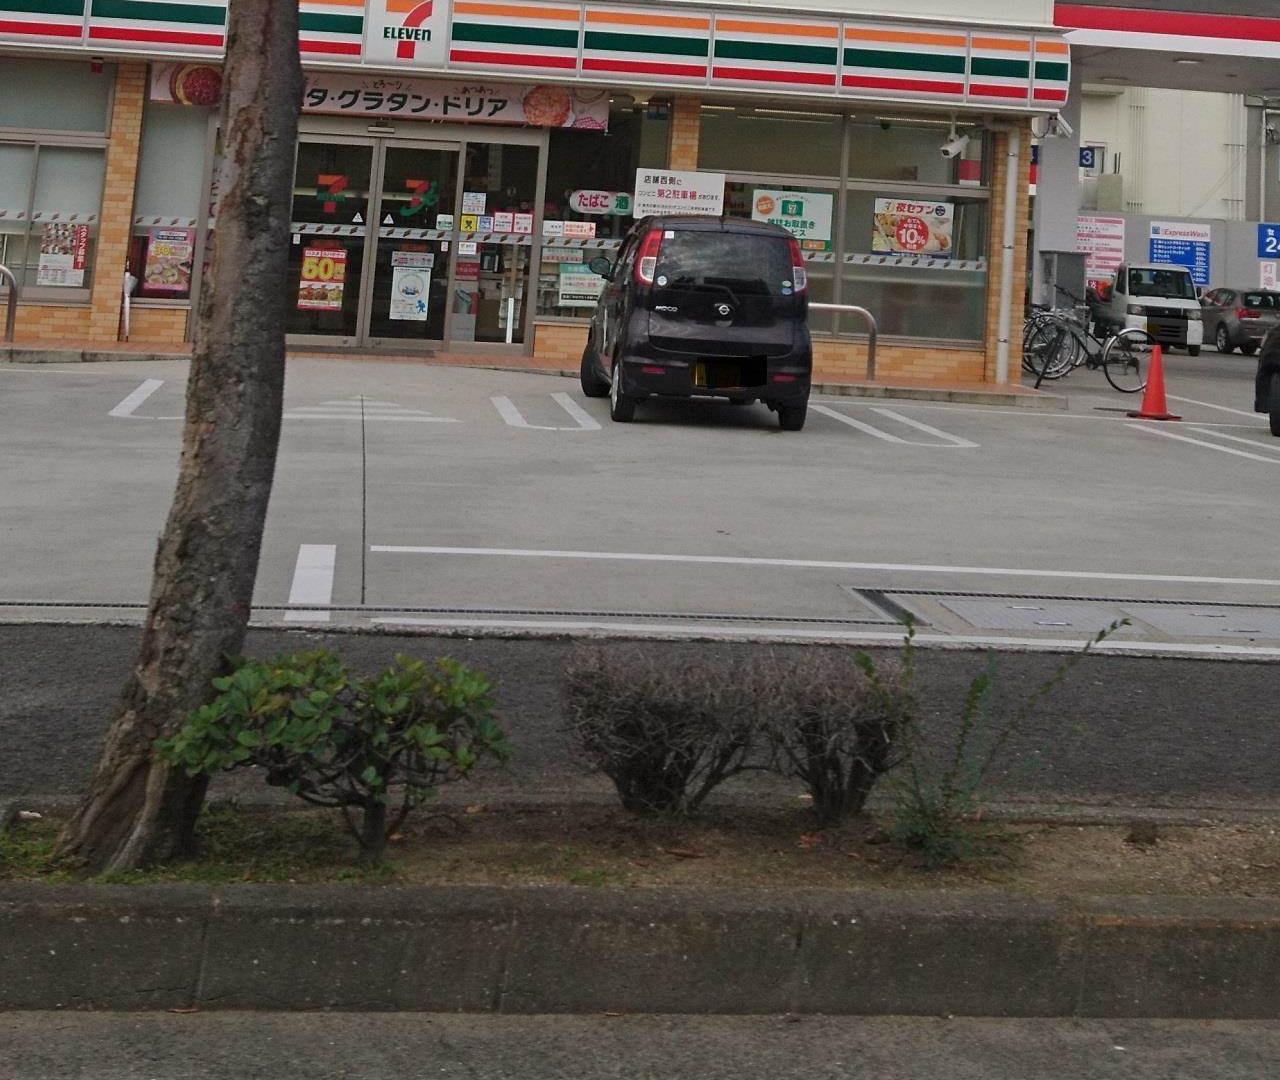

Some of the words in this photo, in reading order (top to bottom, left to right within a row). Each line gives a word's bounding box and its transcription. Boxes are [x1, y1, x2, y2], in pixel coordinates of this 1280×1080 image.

[300, 87, 508, 117] タ・グラタン・ドリア
[1082, 150, 1092, 165] 3
[577, 194, 609, 208] たばこ
[615, 195, 629, 210] 酒
[899, 228, 926, 245] 10%
